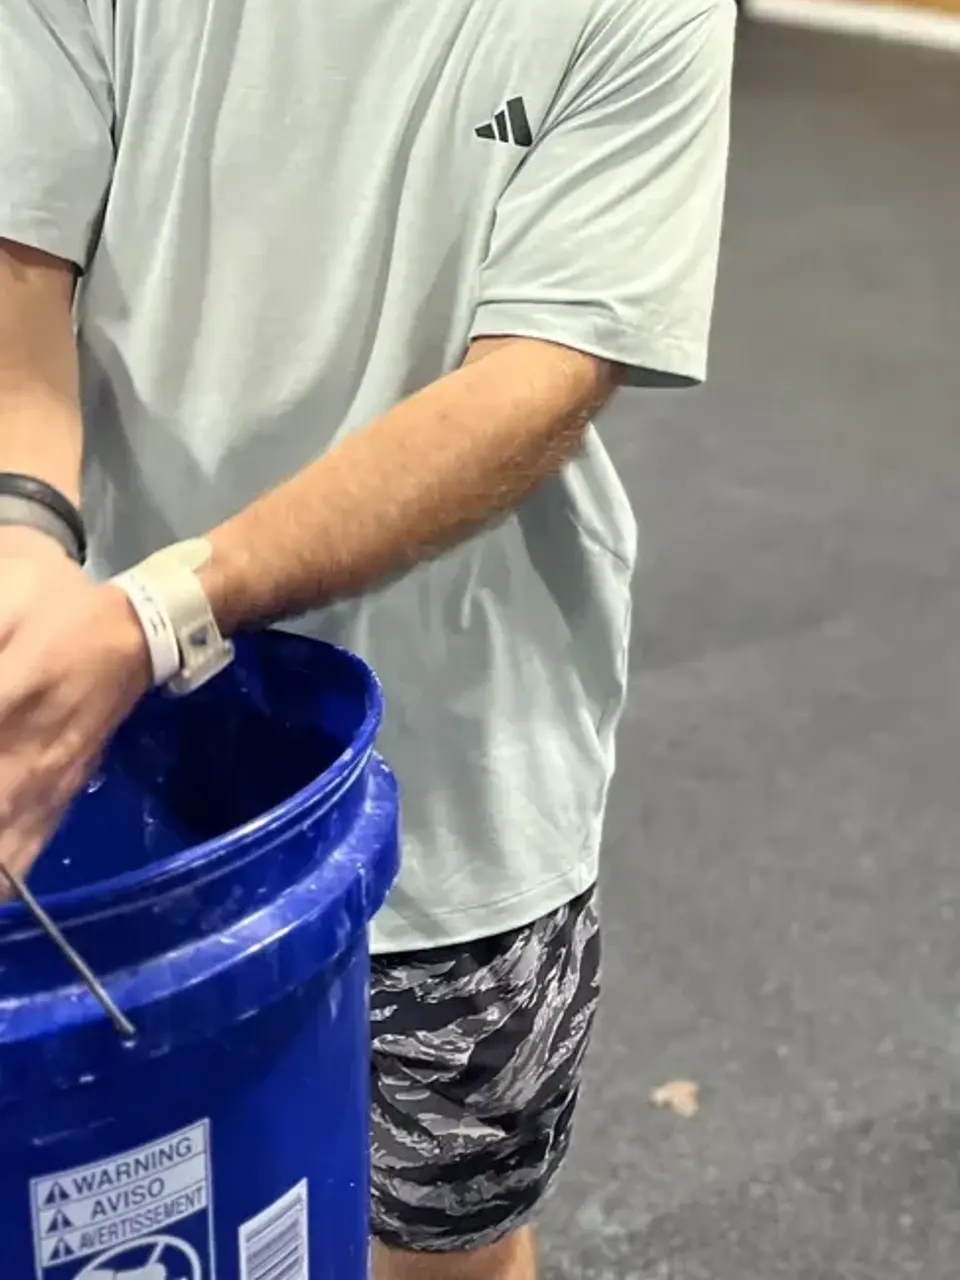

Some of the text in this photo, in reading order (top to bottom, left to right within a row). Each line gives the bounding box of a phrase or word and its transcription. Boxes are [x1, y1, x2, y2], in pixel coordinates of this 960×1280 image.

[72, 1136, 194, 1196] WARNING
[78, 1183, 206, 1252] AVERTISSEMENT
[89, 1178, 166, 1222] AVISO
